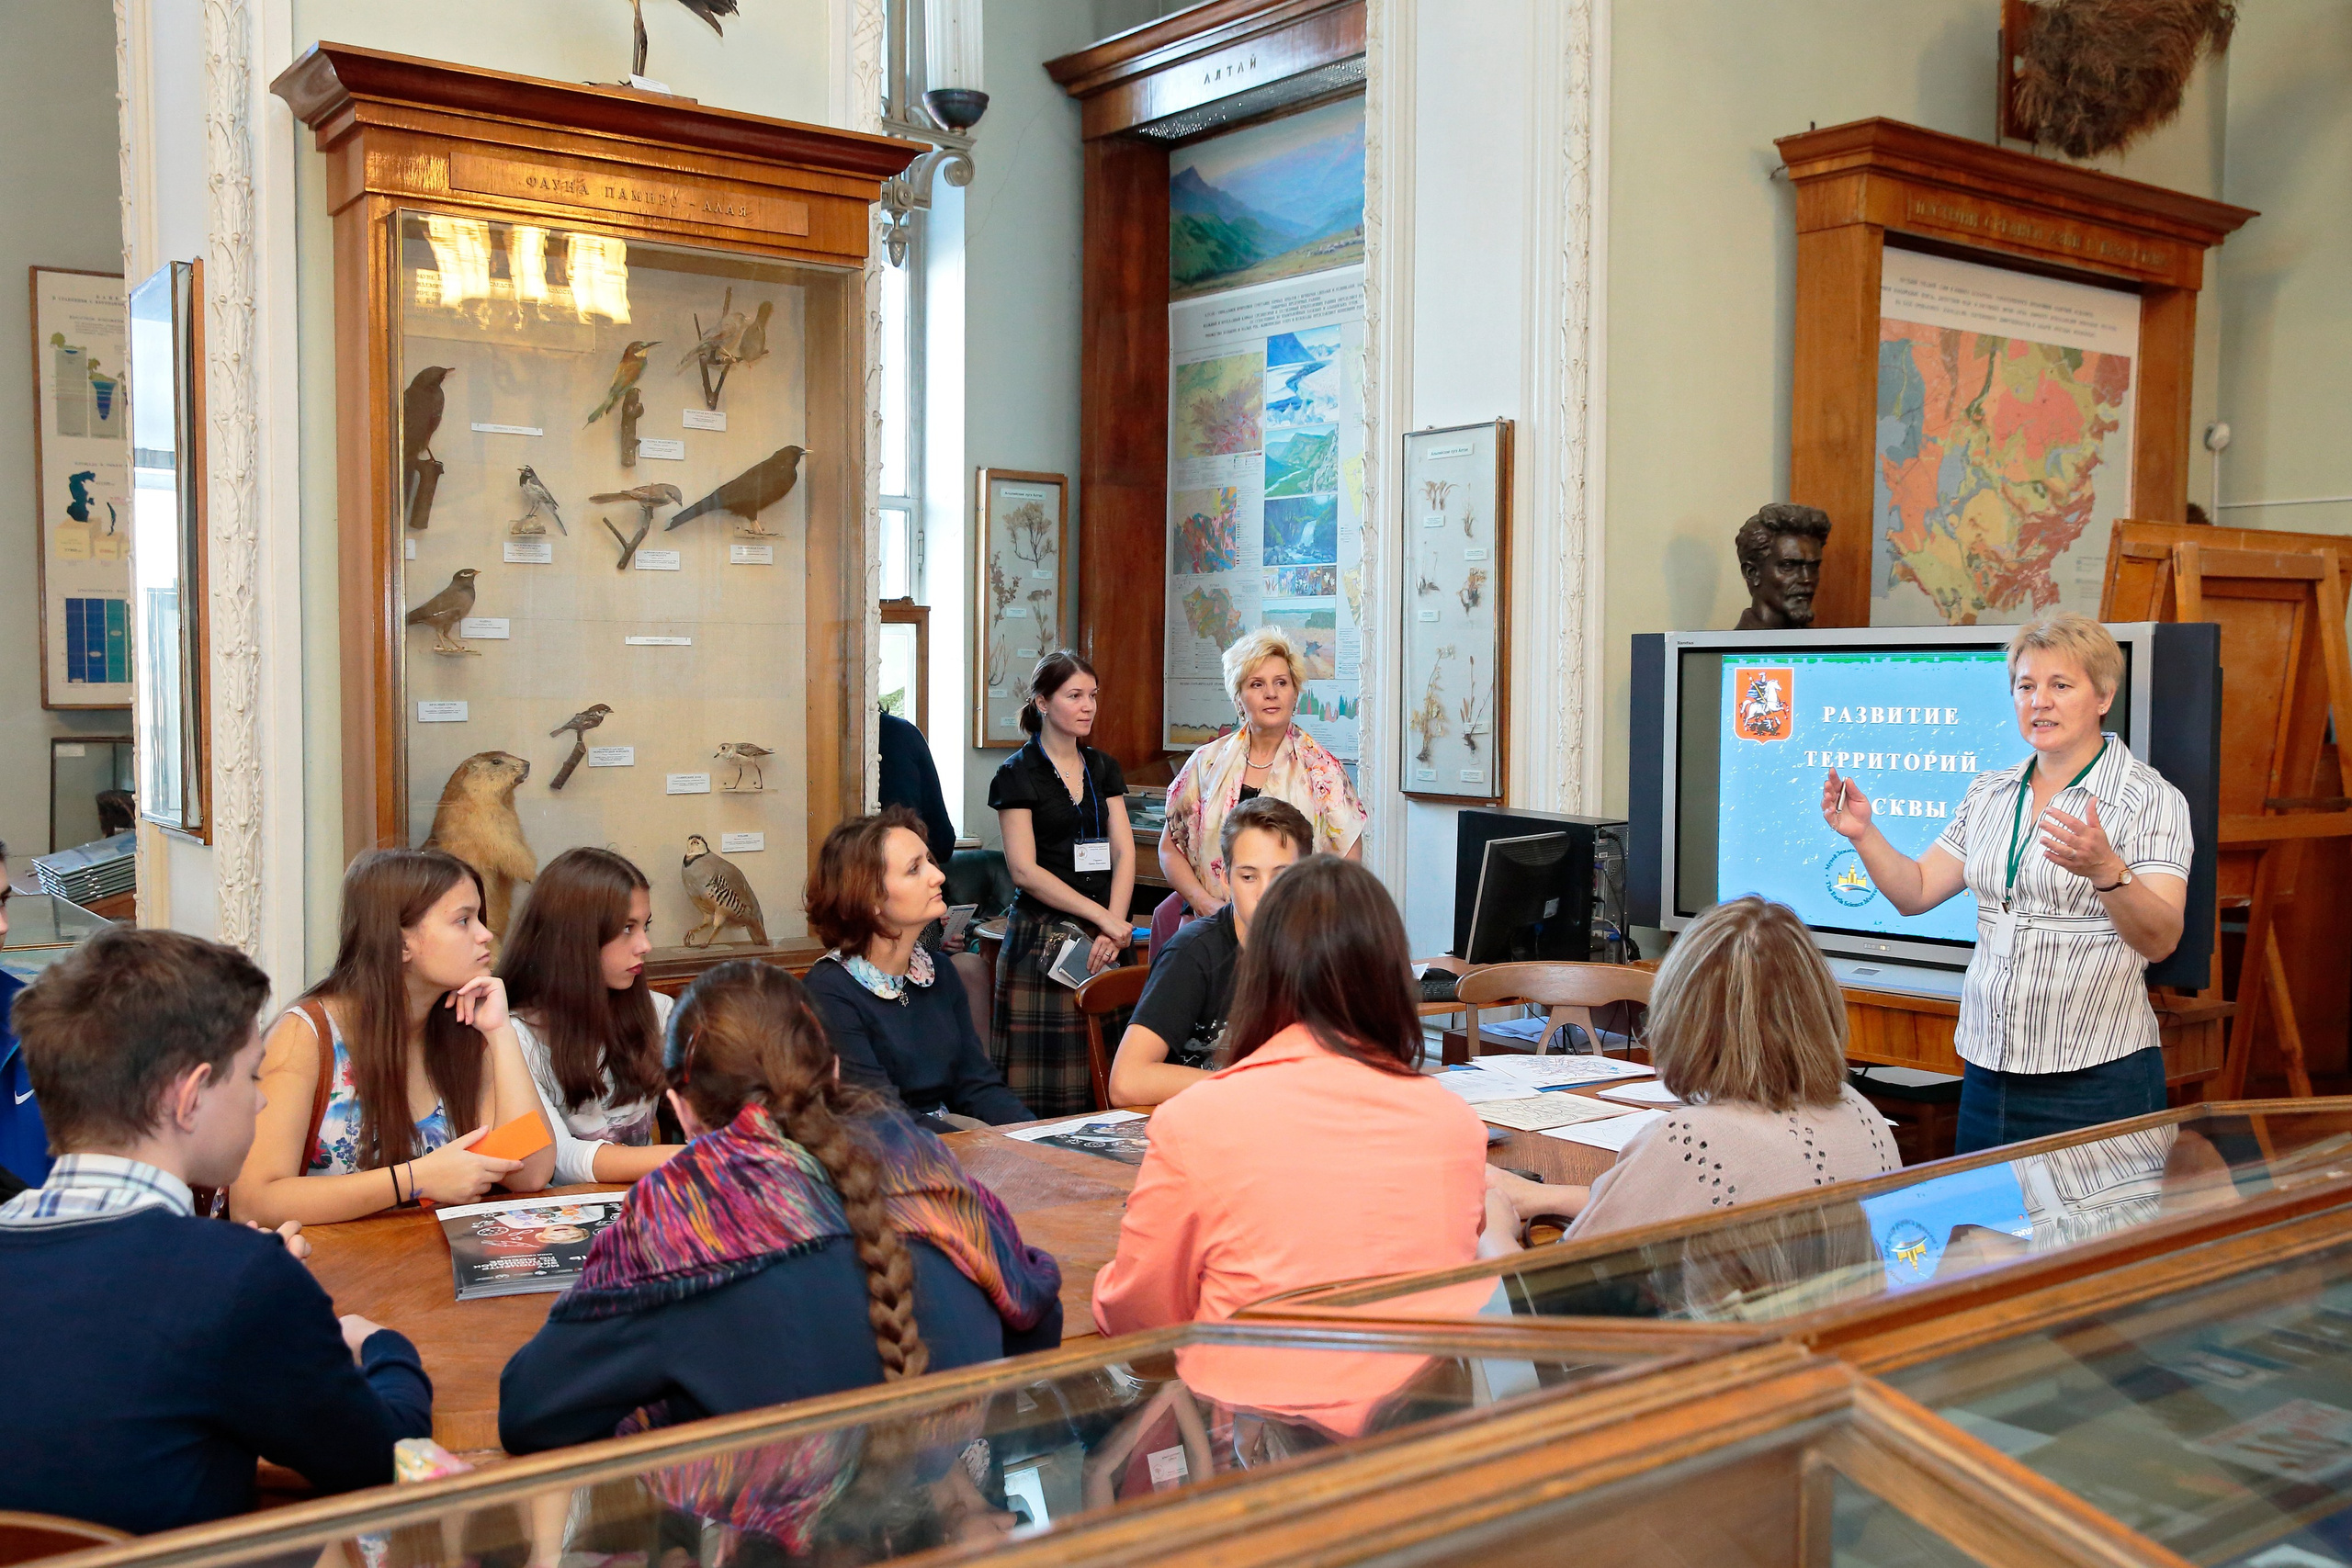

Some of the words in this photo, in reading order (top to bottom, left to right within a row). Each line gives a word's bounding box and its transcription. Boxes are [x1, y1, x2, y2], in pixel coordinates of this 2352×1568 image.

[1204, 53, 1257, 85] АЛТАЙ
[526, 176, 590, 196] ФАУНА
[605, 186, 678, 208] ПАМИРО
[702, 199, 747, 217] АЛАЯ
[1823, 705, 1960, 726] РАЗВИТИЕ
[1804, 750, 1979, 773] ТЕРРИТОРИЙ
[1871, 797, 1948, 819] СКВЫ
[1830, 891, 1844, 905] Earth
[1862, 887, 1879, 905] Museu
